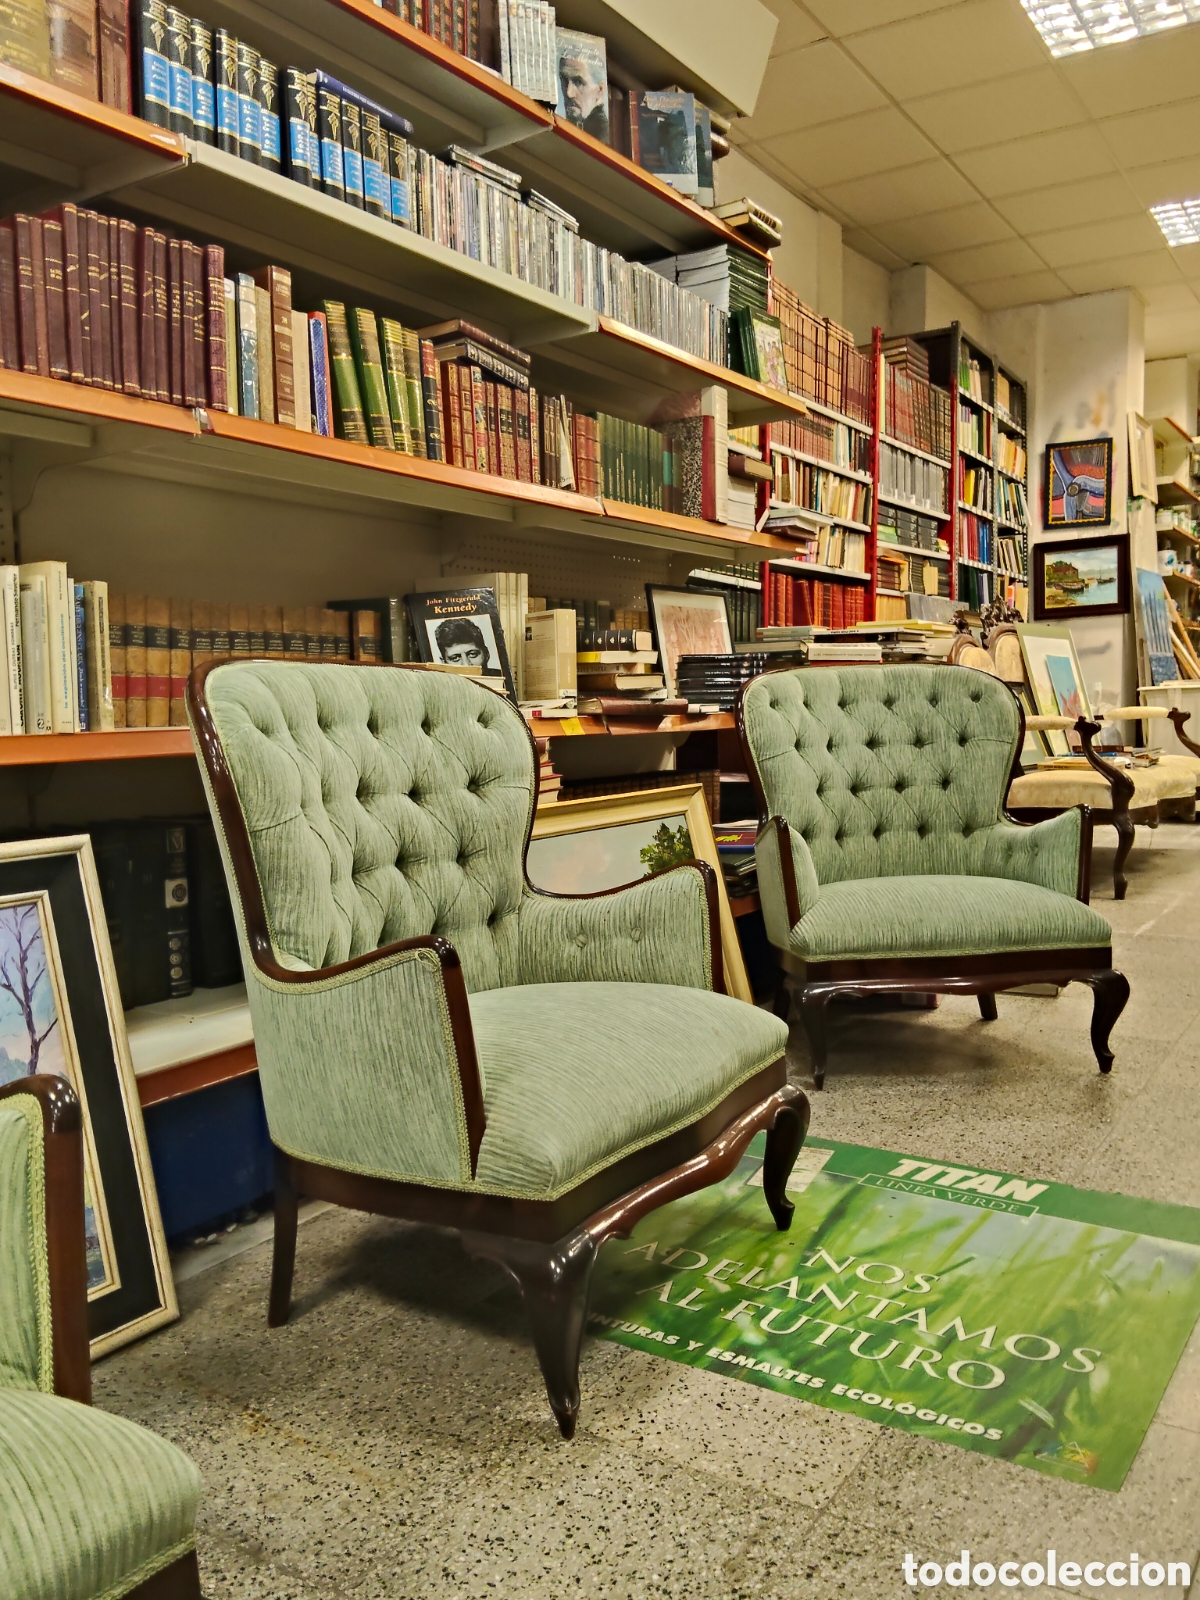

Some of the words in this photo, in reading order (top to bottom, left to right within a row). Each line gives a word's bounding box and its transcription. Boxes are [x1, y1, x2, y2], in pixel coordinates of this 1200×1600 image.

[426, 598, 443, 606] John
[445, 594, 481, 604] Fitzgerald
[434, 603, 477, 614] Kennedy
[887, 1158, 1050, 1202] TITAN
[940, 1190, 1021, 1213] VERDE
[801, 1246, 940, 1294] NOS
[623, 1241, 1101, 1373] ADELANTAMOS
[635, 1280, 707, 1312] AL
[721, 1298, 1006, 1389] FUTURO
[587, 1311, 681, 1345] INTURAS
[686, 1340, 704, 1351] Y
[705, 1348, 826, 1389] ESMALTES
[830, 1383, 1004, 1441] ECOLÓGICOS
